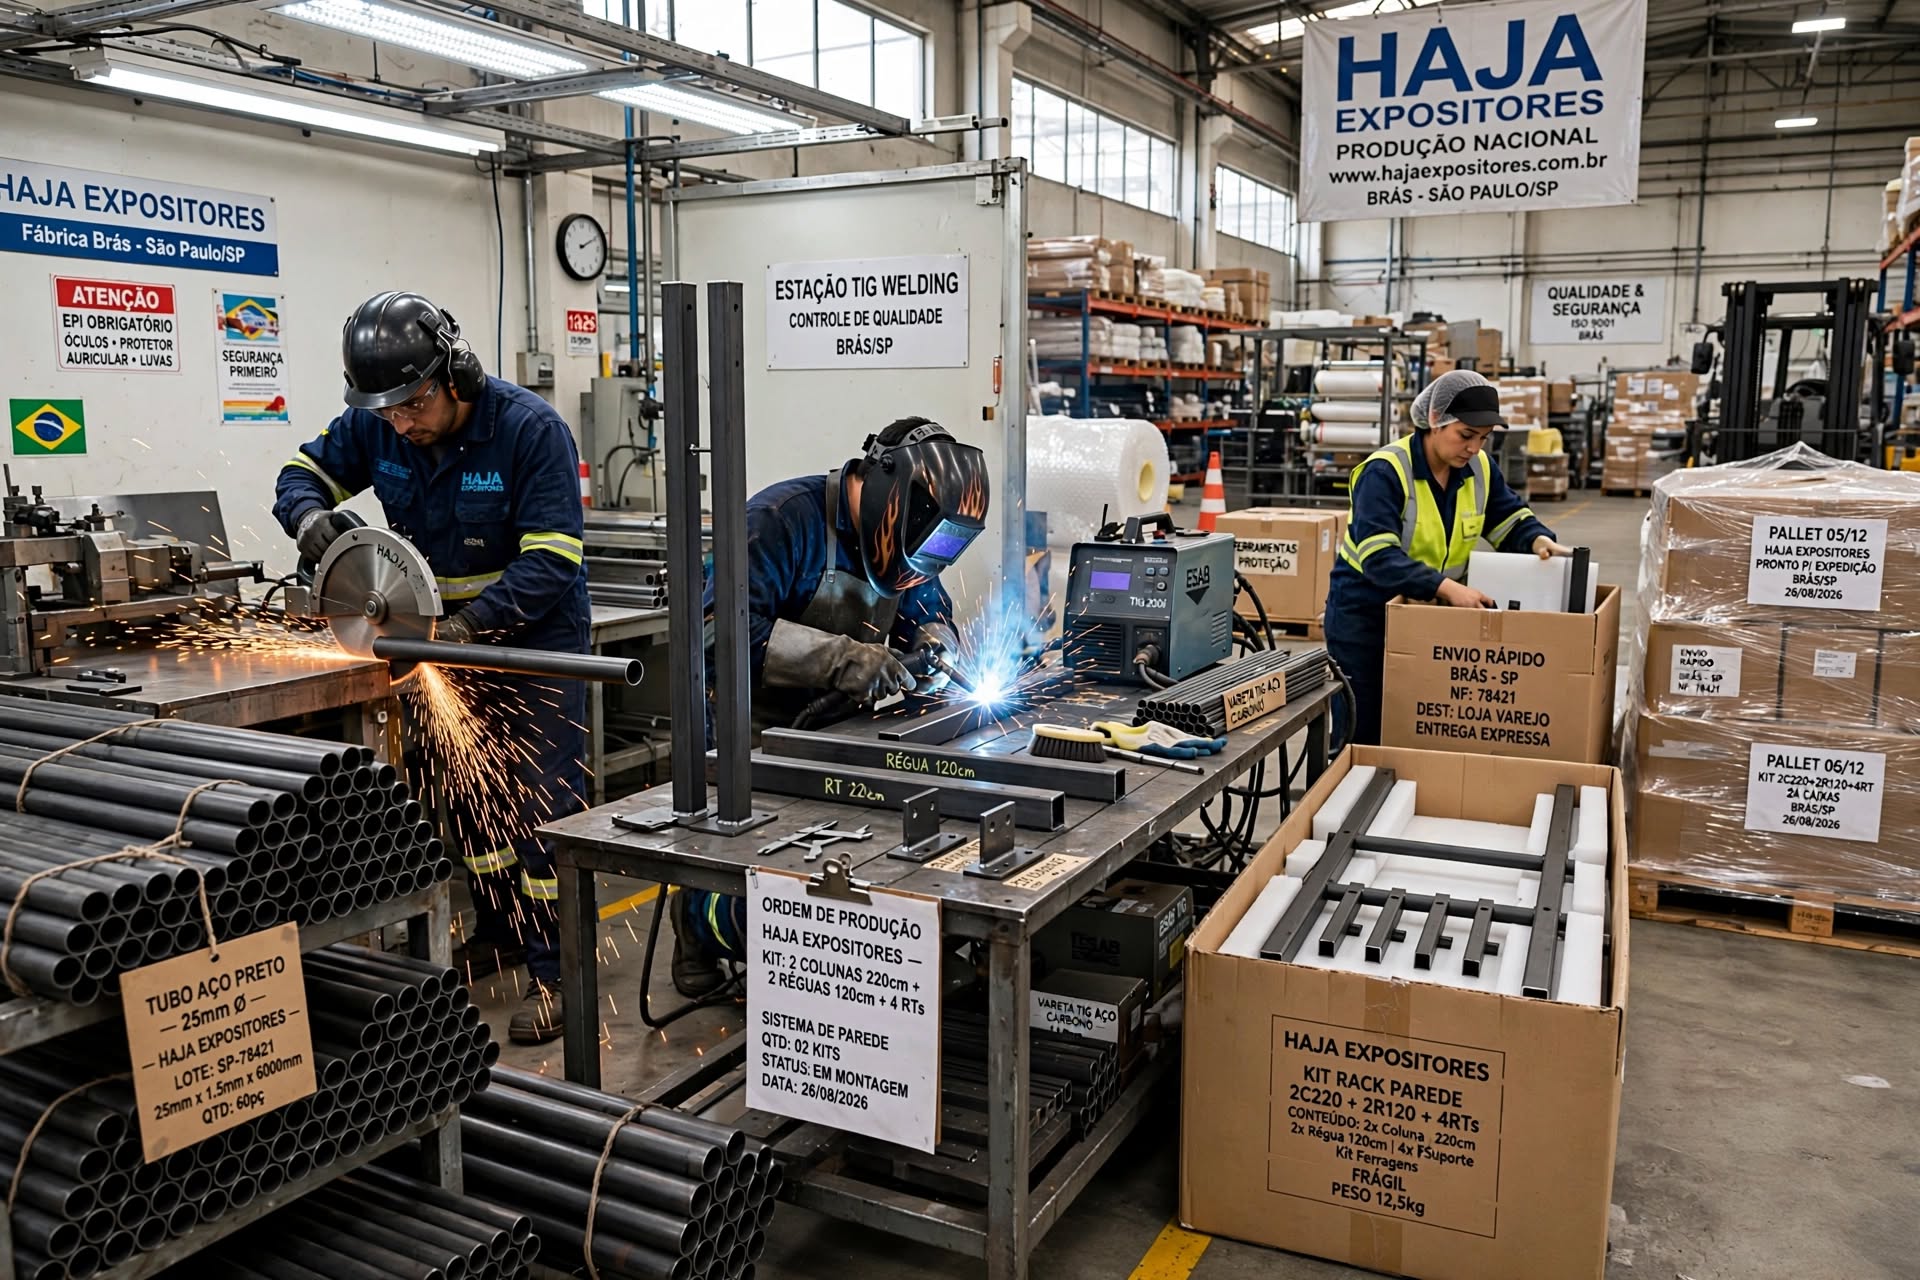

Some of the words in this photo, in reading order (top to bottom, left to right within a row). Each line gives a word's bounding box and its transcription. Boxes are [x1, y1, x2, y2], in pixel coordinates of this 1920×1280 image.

[1337, 13, 1603, 101] HAJA
[1336, 89, 1604, 133] EXPOSITORES
[1337, 134, 1465, 160] PRODUÇÃO
[1474, 126, 1598, 151] NACIONAL
[1329, 152, 1607, 185] www.hajaexpositores.com.br
[0, 174, 75, 209] HAJA
[84, 184, 265, 232] EXPOSITORES
[1367, 186, 1412, 205] BRÁS
[1429, 184, 1464, 201] SÃO
[1470, 180, 1558, 200] PAULO/SP
[22, 223, 88, 248] Fábrica
[93, 231, 131, 252] Brás
[146, 237, 176, 257] São
[180, 241, 245, 264] Paulo/SP
[72, 286, 159, 311] ATENÇÃO
[776, 274, 847, 304] ESTAÇÃO
[852, 276, 877, 297] TIG
[882, 272, 958, 296] WELDING
[1548, 285, 1630, 300] QUALIDADE
[1635, 284, 1643, 297] &
[789, 311, 851, 328] CONTROLE
[854, 311, 869, 326] DE
[873, 308, 943, 327] QUALIDADE
[1553, 302, 1641, 317] SEGURANÇA
[63, 314, 83, 328] EPI
[87, 314, 173, 333] OBRIGATÓRIO
[1571, 319, 1588, 328] ISO
[64, 332, 108, 348] ÓCULOS
[120, 338, 173, 351] PROTETOR
[837, 334, 893, 355] BRÁS/SP
[66, 353, 128, 367] AURICULAR
[140, 355, 173, 367] LUVAS
[222, 350, 283, 366] SEGURANÇA
[230, 366, 277, 378] PRIMEIRO
[462, 472, 502, 485] HAJA
[1769, 526, 1822, 541] PALLET
[1827, 528, 1867, 542] 05/12
[1239, 557, 1290, 572] PROTEÇÃO
[1765, 545, 1793, 555] HAJA
[1796, 546, 1870, 559] EXPOSITORES
[1186, 565, 1210, 588] ESAB
[1756, 559, 1799, 570] PRONTO
[1802, 561, 1812, 571] P/
[1816, 561, 1876, 575] EXPEDIÇÃO
[1793, 572, 1837, 586] BRÁS/SP
[1785, 588, 1842, 599] 26/08/2026
[1433, 646, 1480, 662] ENVIO
[1486, 647, 1545, 667] RÁPIDO
[1451, 665, 1487, 683] BRÁS
[1501, 671, 1518, 685] SP
[1451, 687, 1472, 700] NF:
[1478, 689, 1516, 704] 78421
[1417, 702, 1454, 718] DEST:
[1458, 706, 1492, 722] LOJA
[1496, 710, 1550, 727] VAREJO
[1416, 721, 1476, 739] ENTREGA
[1481, 728, 1550, 747] EXPRESSA
[886, 752, 928, 772] RÉGUA
[936, 760, 975, 777] 120cm
[1767, 754, 1820, 770] PALLET
[825, 778, 842, 795] RT
[1758, 772, 1776, 782] KIT
[1783, 815, 1840, 829] 26/08/2026
[762, 897, 812, 919] ORDEM
[816, 906, 834, 924] DE
[839, 910, 921, 940] PRODUÇÃO
[762, 924, 798, 945] HAJA
[803, 931, 903, 964] EXPOSITORES
[762, 950, 785, 968] KIT:
[789, 955, 796, 969] 2
[800, 957, 862, 983] COLUNAS
[867, 971, 908, 992] 220cm
[146, 986, 193, 1015] TUBO
[198, 974, 231, 999] AÇO
[235, 956, 284, 986] PRETO
[768, 971, 775, 985] 2
[779, 969, 830, 996] RÉGUAS
[835, 984, 874, 1006] 120cm
[890, 996, 897, 1010] 4
[902, 998, 924, 1015] RTs
[182, 1004, 230, 1030] 25mm
[1038, 998, 1074, 1014] VARETA
[1077, 1006, 1091, 1018] TIG
[1095, 1008, 1116, 1022] AÇO
[159, 1043, 196, 1068] HAJA
[200, 1009, 286, 1053] EXPOSITORES
[762, 1011, 814, 1033] SISTEMA
[818, 1022, 834, 1039] DE
[838, 1027, 889, 1050] PAREDE
[762, 1032, 790, 1050] QTD:
[794, 1040, 808, 1055] 02
[813, 1043, 840, 1061] KITS
[1285, 1031, 1339, 1056] HAJA
[1345, 1042, 1489, 1081] EXPOSITORES
[175, 1064, 214, 1090] LOTE:
[218, 1040, 274, 1073] SP-78421
[762, 1053, 810, 1076] STATUS:
[813, 1064, 831, 1080] EM
[836, 1068, 908, 1097] MONTAGEM
[154, 1096, 192, 1120] 25mm
[196, 1092, 203, 1105] x
[206, 1079, 243, 1101] 1.5mm
[247, 1072, 254, 1084] x
[256, 1053, 302, 1079] 6000mm
[762, 1073, 797, 1094] DATA:
[801, 1082, 868, 1110] 26/08/2026
[1304, 1066, 1330, 1084] KIT
[1336, 1072, 1384, 1094] RACK
[1390, 1080, 1462, 1108] PAREDE
[202, 1104, 233, 1124] QTD:
[1290, 1084, 1341, 1108] 2C220
[1363, 1097, 1415, 1121] 2R120
[1438, 1111, 1479, 1133] 4RTs
[1288, 1106, 1359, 1130] CONTEÚDO:
[1363, 1120, 1378, 1133] 2x
[1382, 1122, 1424, 1142] Coluna
[1435, 1133, 1475, 1150] 220cm
[1291, 1122, 1304, 1135] 2x
[1308, 1126, 1344, 1144] Régua
[1348, 1133, 1387, 1151] 120cm
[1398, 1142, 1413, 1156] 4x
[1336, 1146, 1352, 1160] Kit
[1356, 1151, 1418, 1173] Ferragens
[1352, 1167, 1406, 1192] FRÁGIL
[1332, 1182, 1370, 1203] PESO
[1376, 1191, 1425, 1217] 12,5kg
